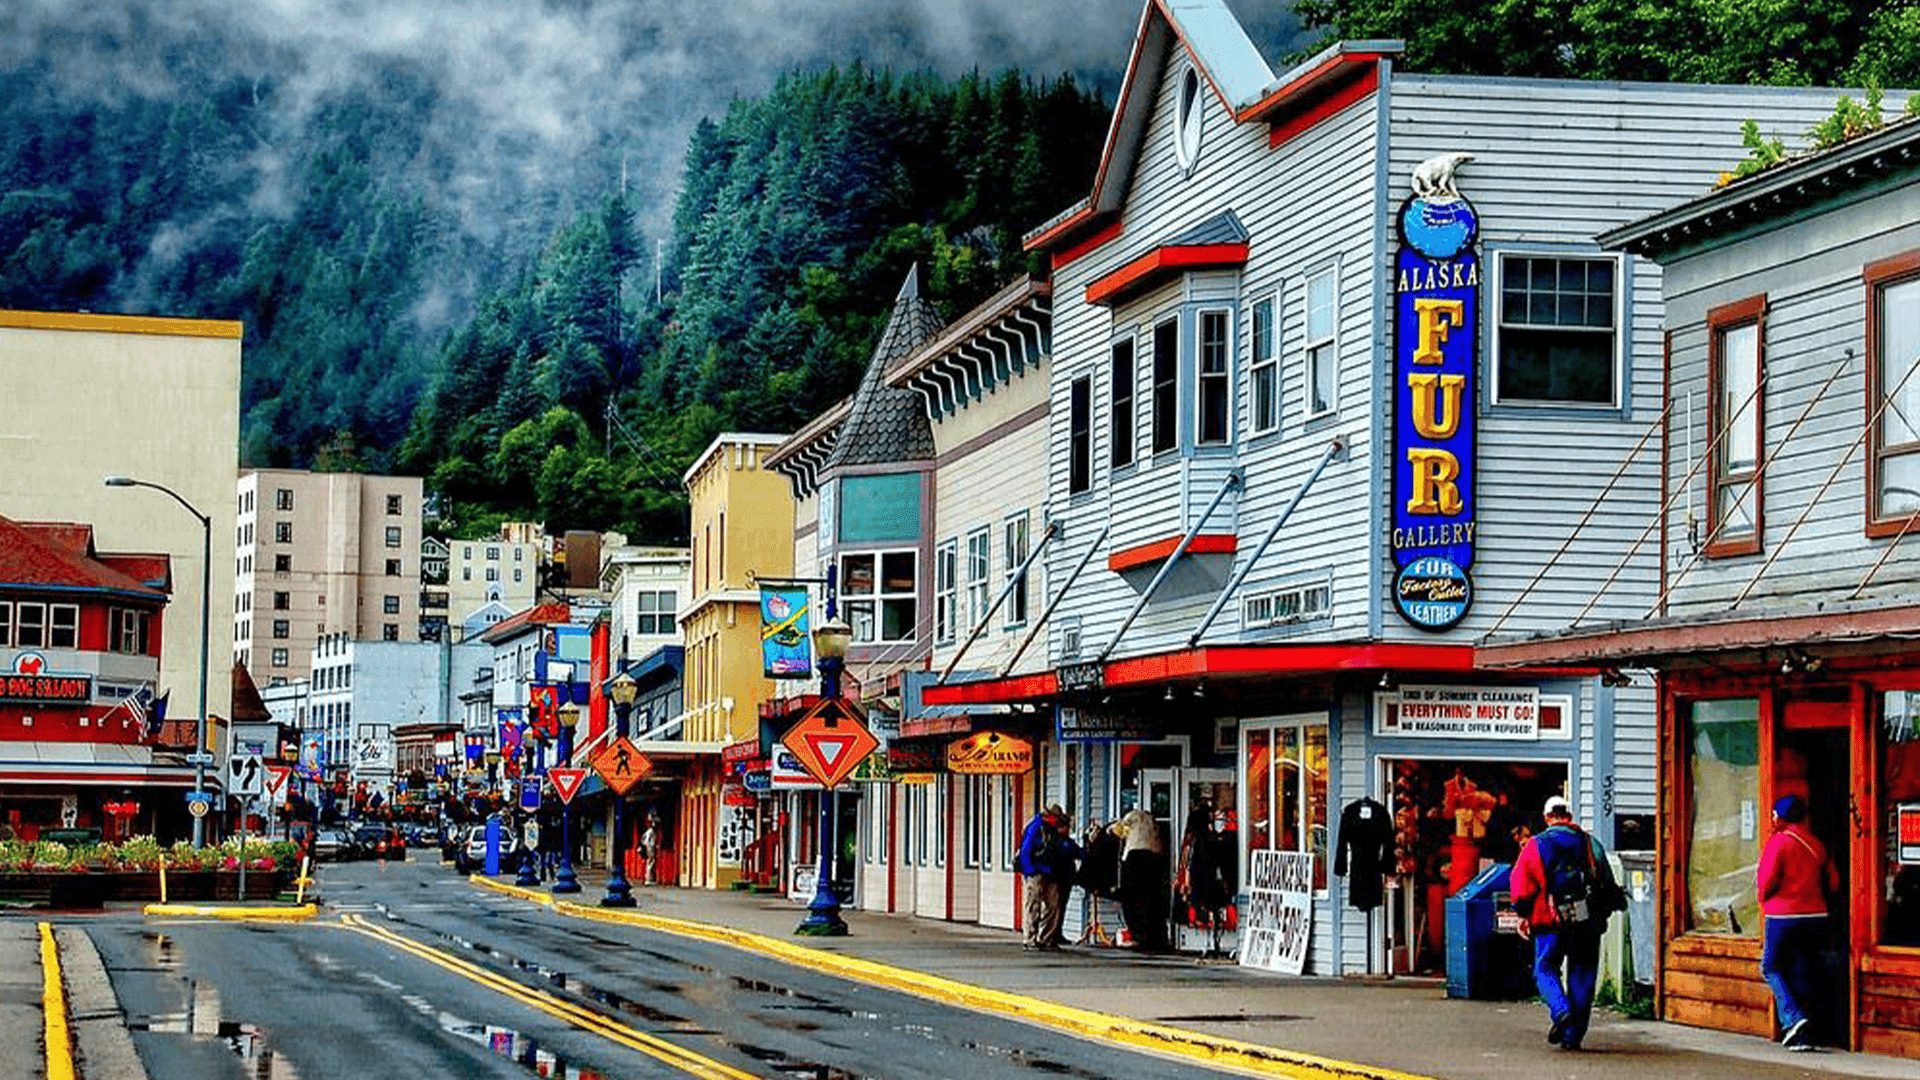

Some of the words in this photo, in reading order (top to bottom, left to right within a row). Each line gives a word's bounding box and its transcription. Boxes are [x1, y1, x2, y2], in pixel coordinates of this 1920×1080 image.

[1397, 262, 1477, 292] ALASKA
[1407, 298, 1464, 516] FUR
[1393, 522, 1475, 548] GALLERY
[1414, 560, 1453, 577] FUR
[1401, 578, 1452, 595] Factory
[1428, 585, 1468, 601] Outlet
[1409, 604, 1457, 625] LEATHER
[9, 678, 34, 698] DOG
[36, 679, 87, 699] SALOON
[1403, 691, 1421, 700] END
[1424, 691, 1434, 700] OF
[1439, 691, 1478, 701] SUMMER
[1481, 692, 1533, 703] CLEARANCE
[1402, 703, 1472, 719] EVERYTHING
[1477, 705, 1508, 720] MUST
[1514, 706, 1534, 721] GO!
[1402, 722, 1412, 730] NO
[1416, 722, 1465, 732] REASONABLE
[1468, 723, 1491, 733] OFFER
[1495, 724, 1532, 734] REFUSED!
